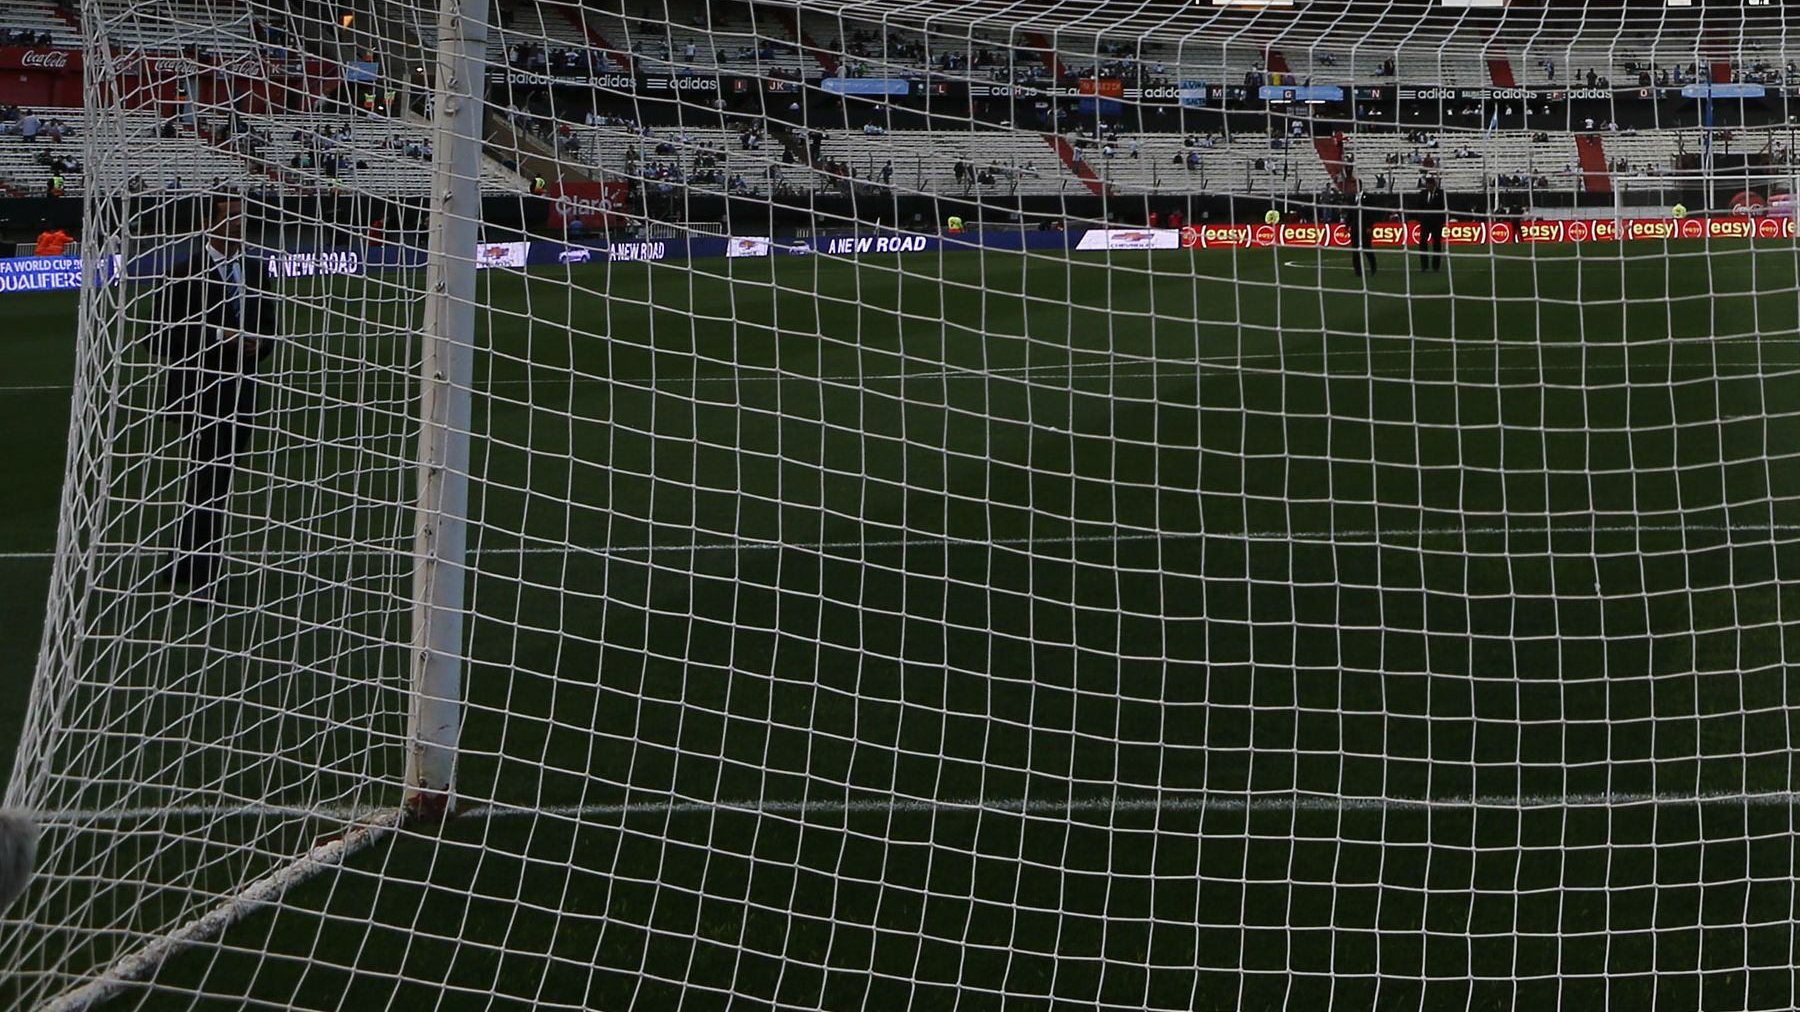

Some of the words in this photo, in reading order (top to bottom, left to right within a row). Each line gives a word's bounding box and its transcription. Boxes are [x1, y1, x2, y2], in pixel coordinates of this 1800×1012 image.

[589, 73, 637, 88] adidas
[669, 75, 717, 91] adidas
[1493, 88, 1538, 99] adidas
[555, 195, 612, 215] Claro
[837, 237, 872, 253] NEW
[875, 235, 927, 252] ROAD
[14, 260, 50, 272] WORLD
[53, 259, 73, 270] CUP
[284, 253, 315, 277] NEW
